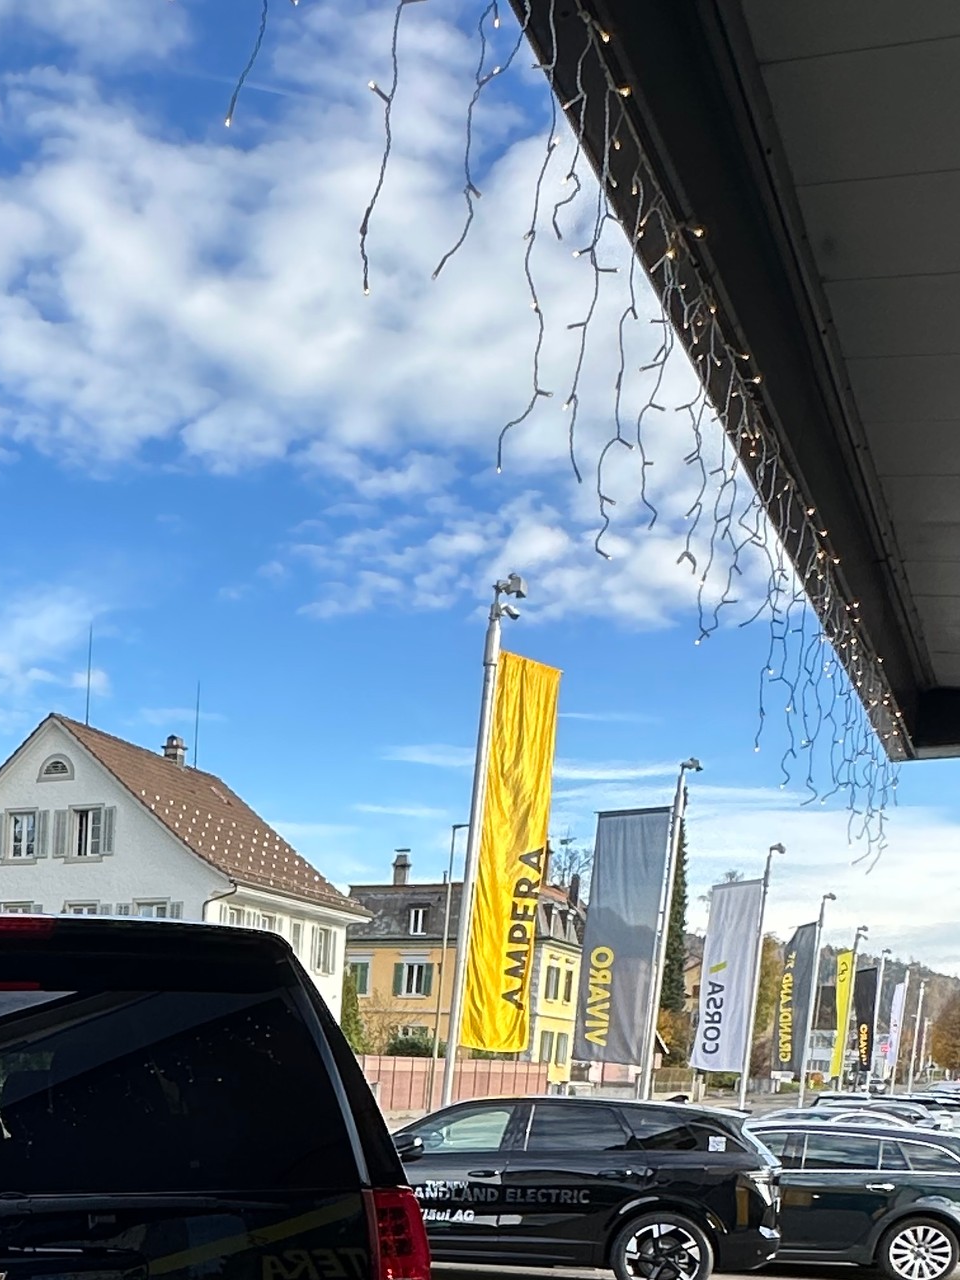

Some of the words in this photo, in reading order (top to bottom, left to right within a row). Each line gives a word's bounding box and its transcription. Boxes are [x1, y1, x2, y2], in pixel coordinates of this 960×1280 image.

[501, 846, 544, 1011] AMPERA
[414, 1187, 499, 1202] ANDLAND
[505, 1188, 591, 1204] ELECTRIC
[420, 1208, 452, 1221] läui
[452, 1209, 475, 1222] AG
